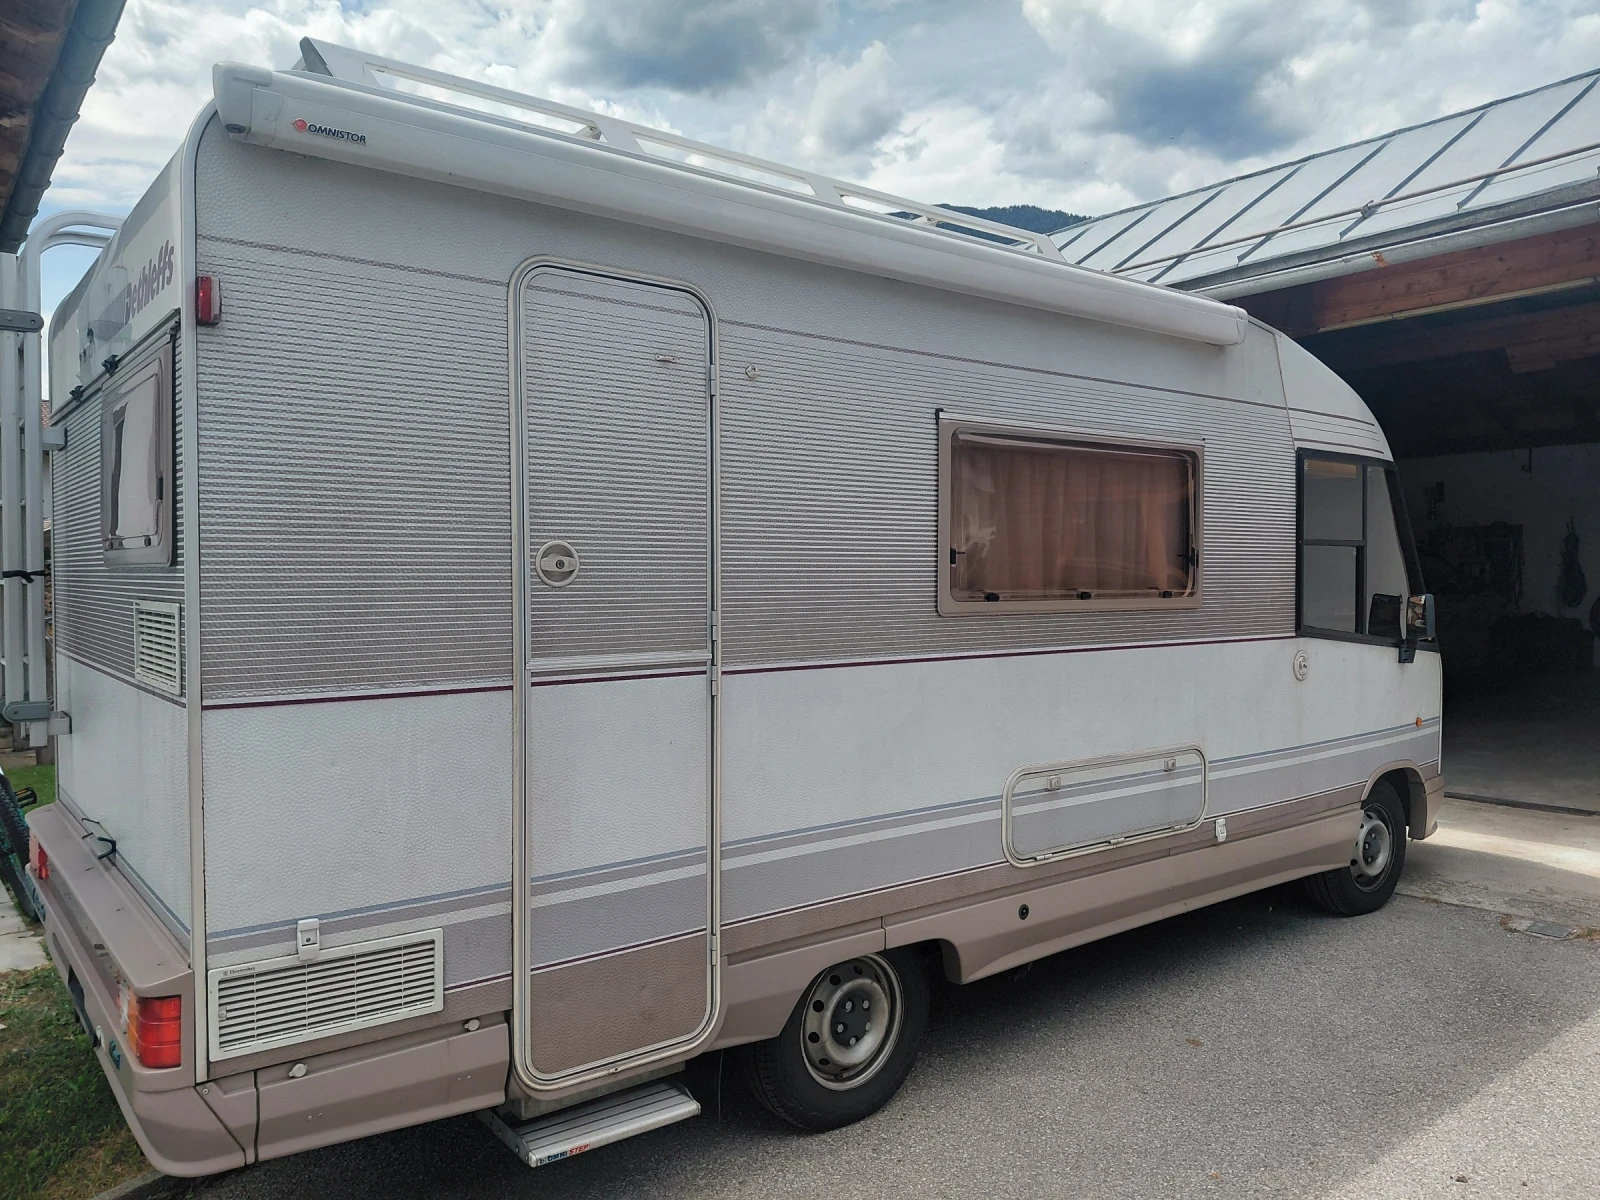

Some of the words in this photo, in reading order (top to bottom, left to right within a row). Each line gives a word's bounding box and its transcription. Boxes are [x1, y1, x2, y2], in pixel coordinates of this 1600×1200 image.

[308, 123, 366, 144] OMNISTOR
[124, 239, 175, 326] Dethleffs
[547, 1150, 568, 1162] OMNI
[568, 1143, 589, 1156] STEP
